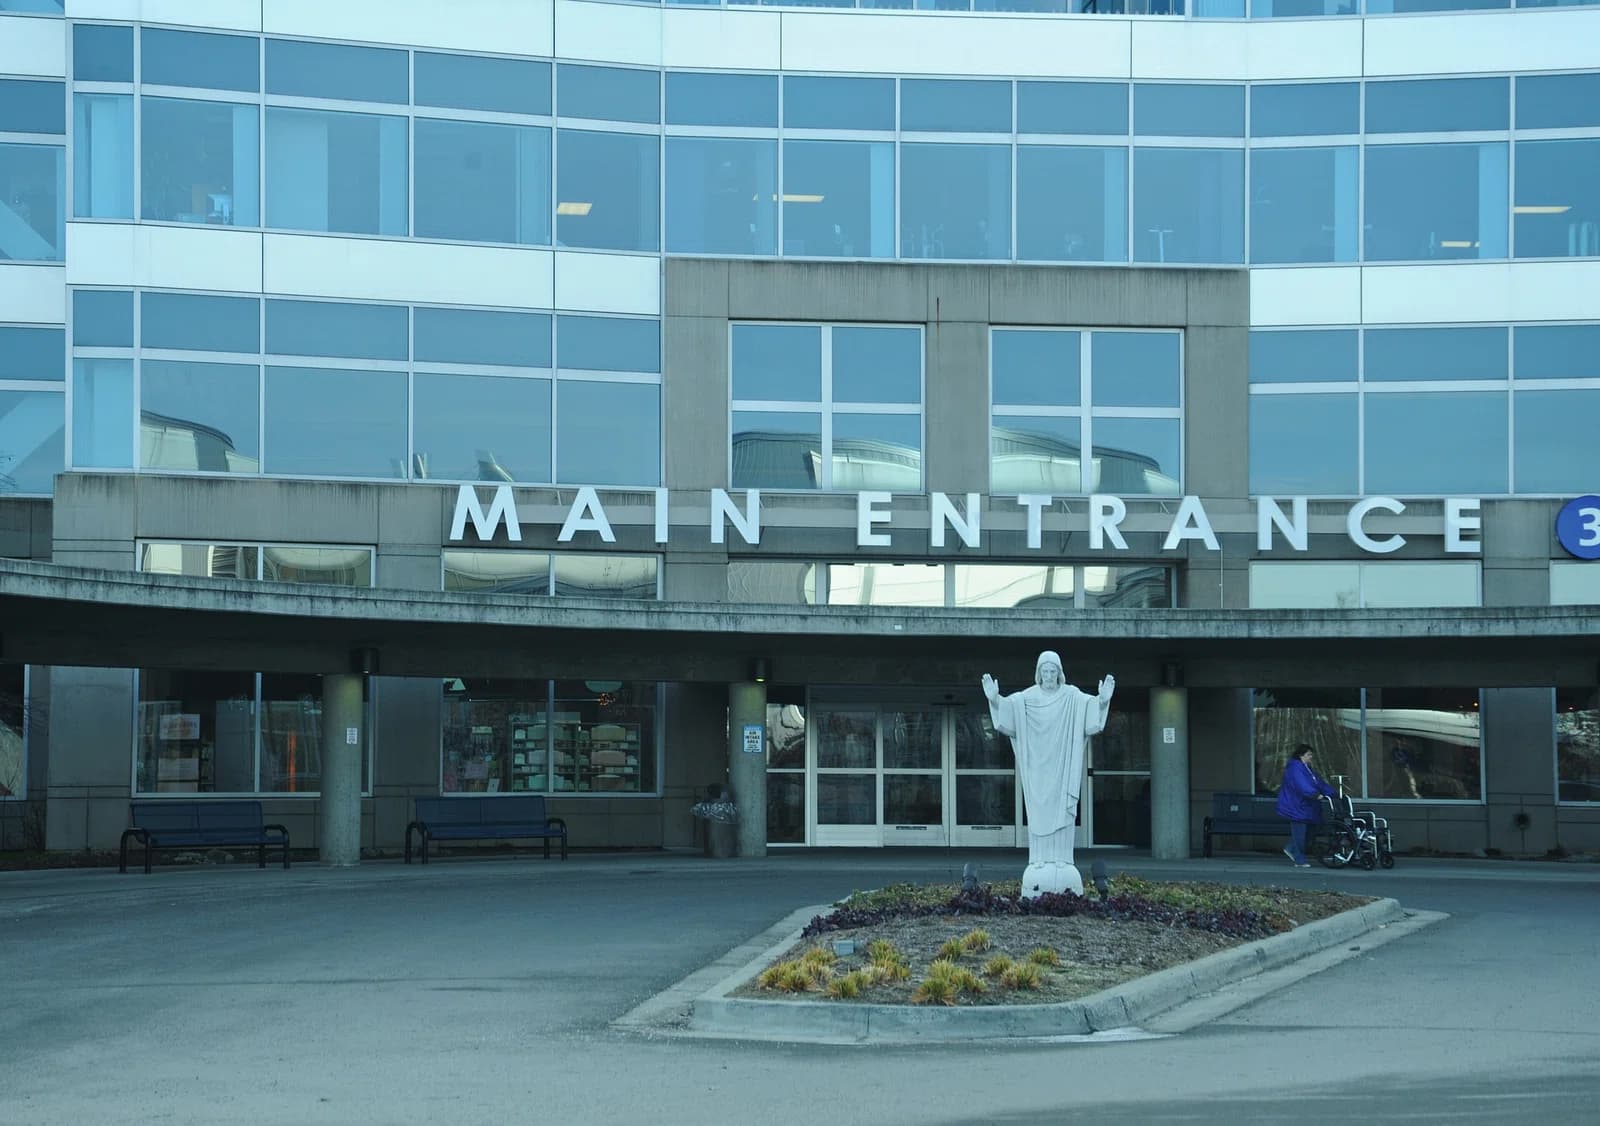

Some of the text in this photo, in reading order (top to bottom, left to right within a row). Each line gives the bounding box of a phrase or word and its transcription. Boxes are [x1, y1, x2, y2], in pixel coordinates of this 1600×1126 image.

[449, 485, 1481, 553] MAIN ENTRANCE
[1578, 507, 1600, 546] 3
